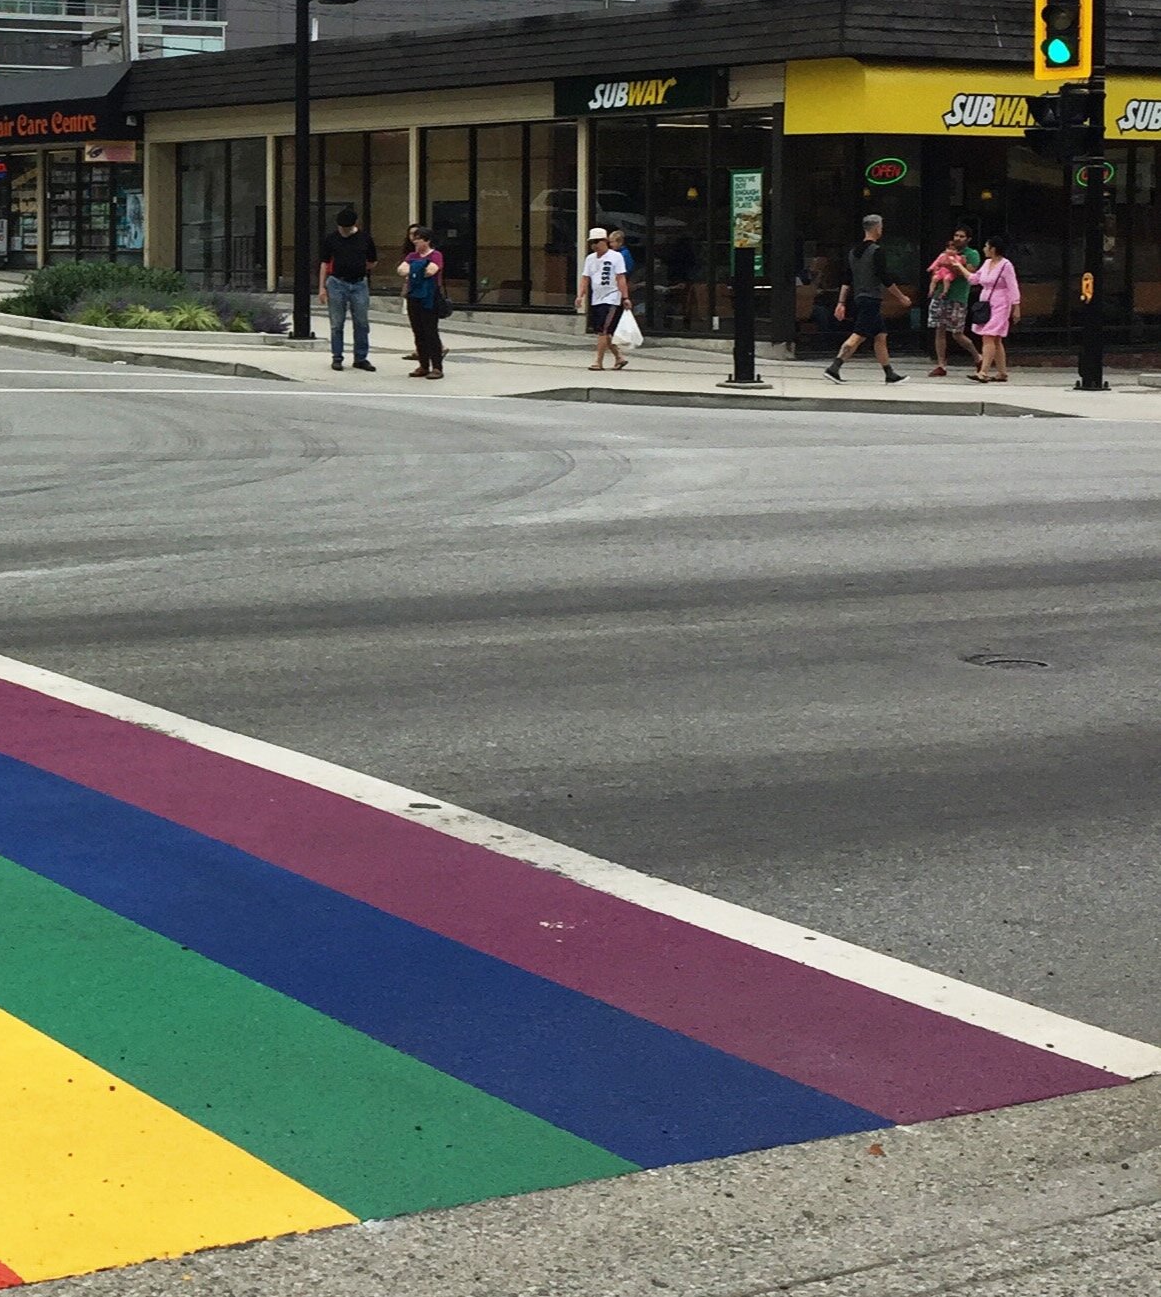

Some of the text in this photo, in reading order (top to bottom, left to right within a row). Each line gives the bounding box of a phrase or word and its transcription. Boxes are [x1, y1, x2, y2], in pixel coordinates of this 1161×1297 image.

[588, 77, 677, 110] SUBWAY
[17, 114, 48, 136] Care
[51, 112, 96, 134] Centre
[942, 93, 1039, 131] SUBWA
[870, 163, 902, 179] OPEN
